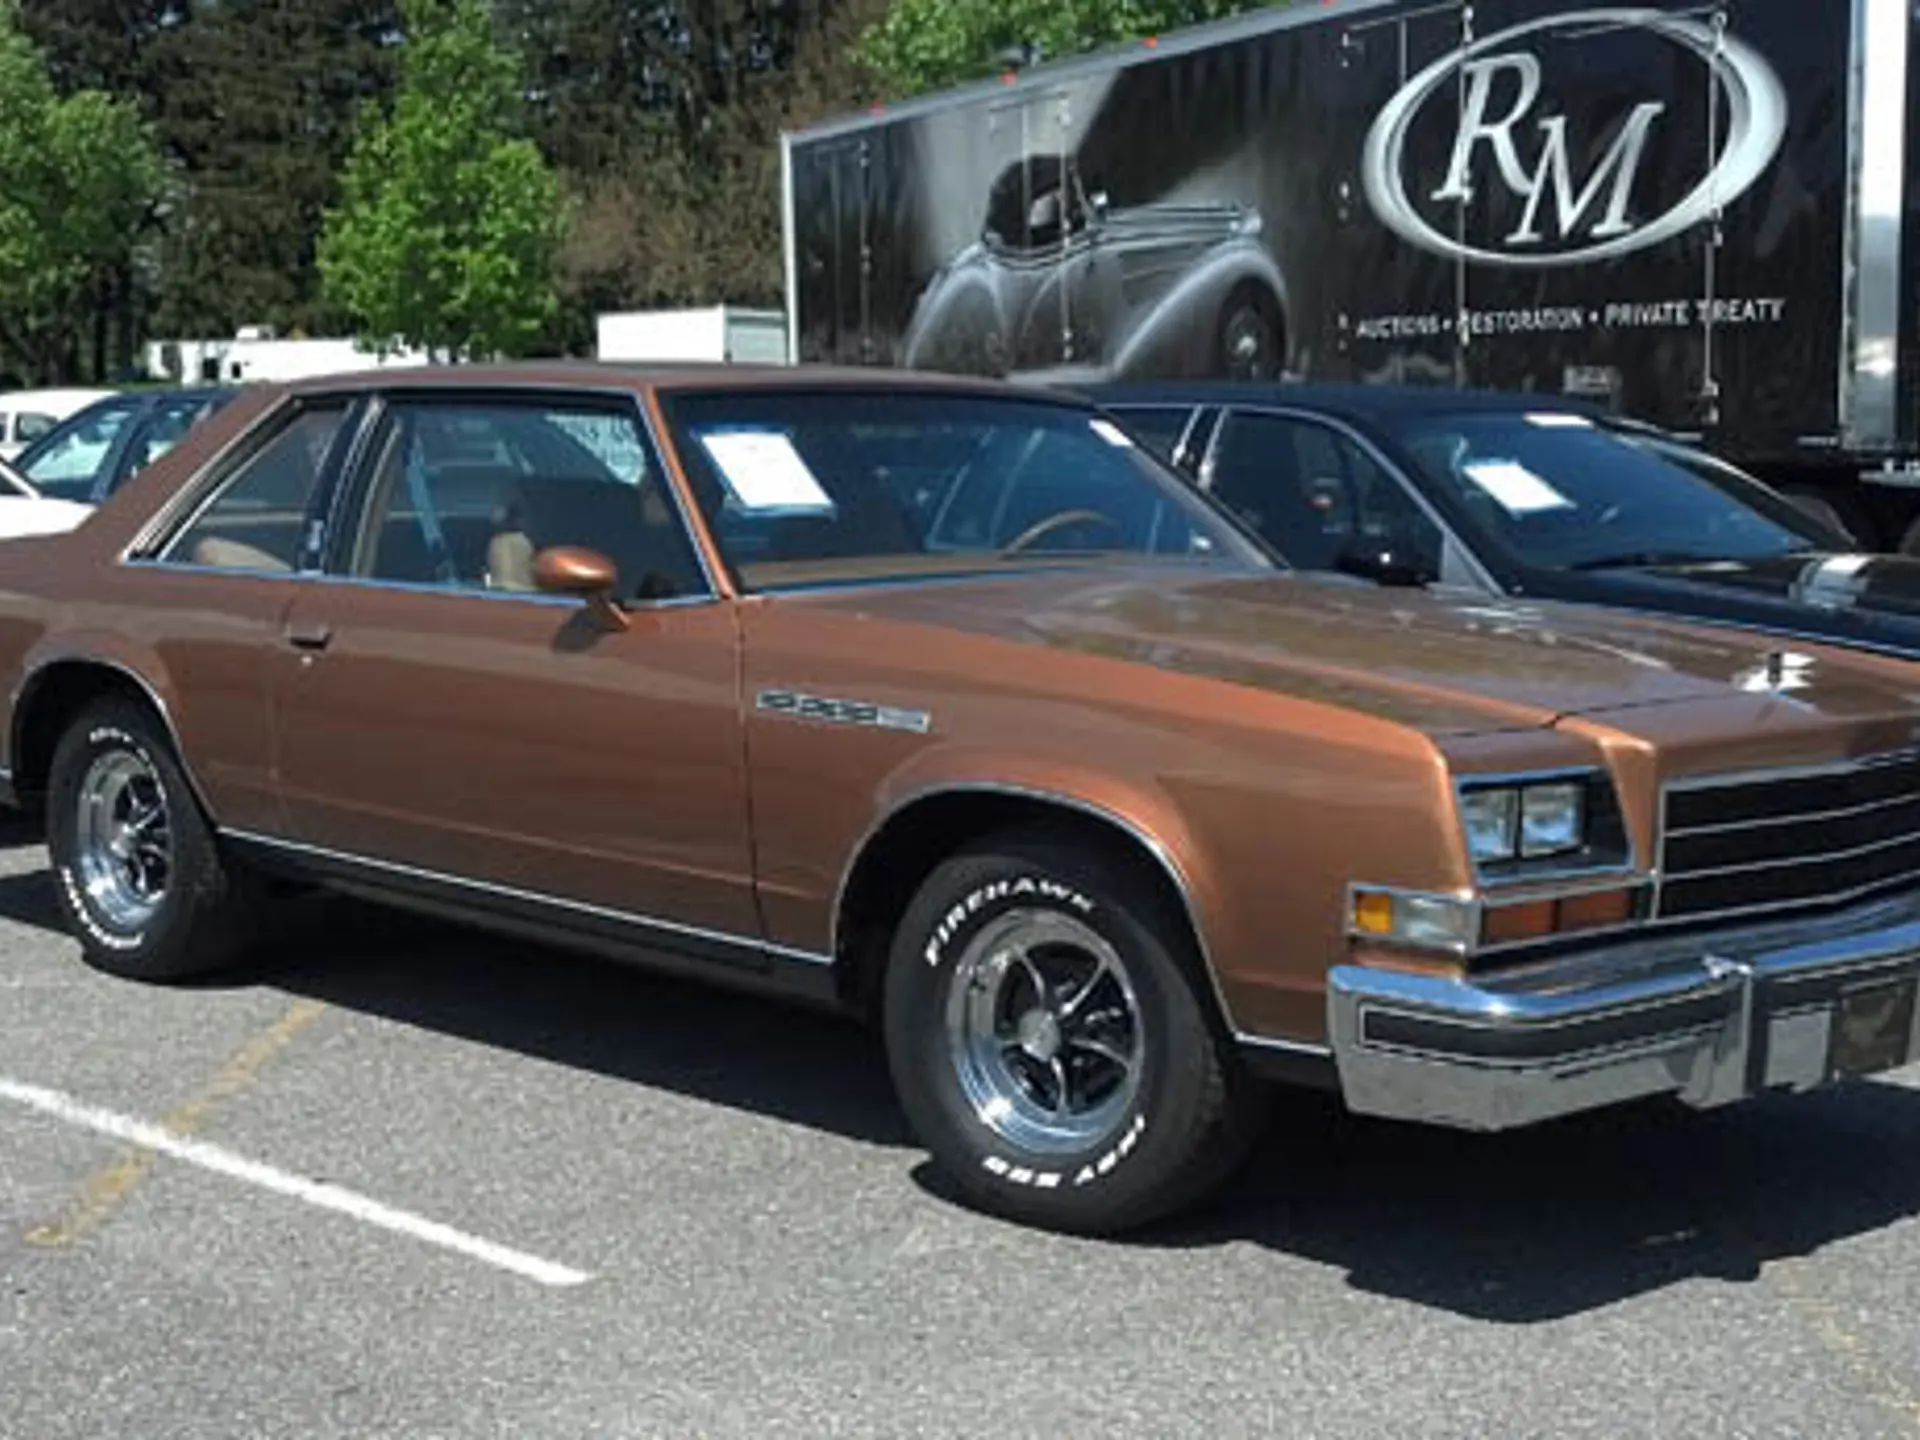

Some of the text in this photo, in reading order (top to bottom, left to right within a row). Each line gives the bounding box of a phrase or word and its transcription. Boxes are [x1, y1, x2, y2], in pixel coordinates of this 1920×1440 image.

[1430, 52, 1665, 244] RM
[1356, 314, 1440, 339] AUCTIONS
[1604, 300, 1690, 327] PRIVATE
[1694, 297, 1786, 322] TREATY
[925, 877, 1094, 966] FIREHAWK
